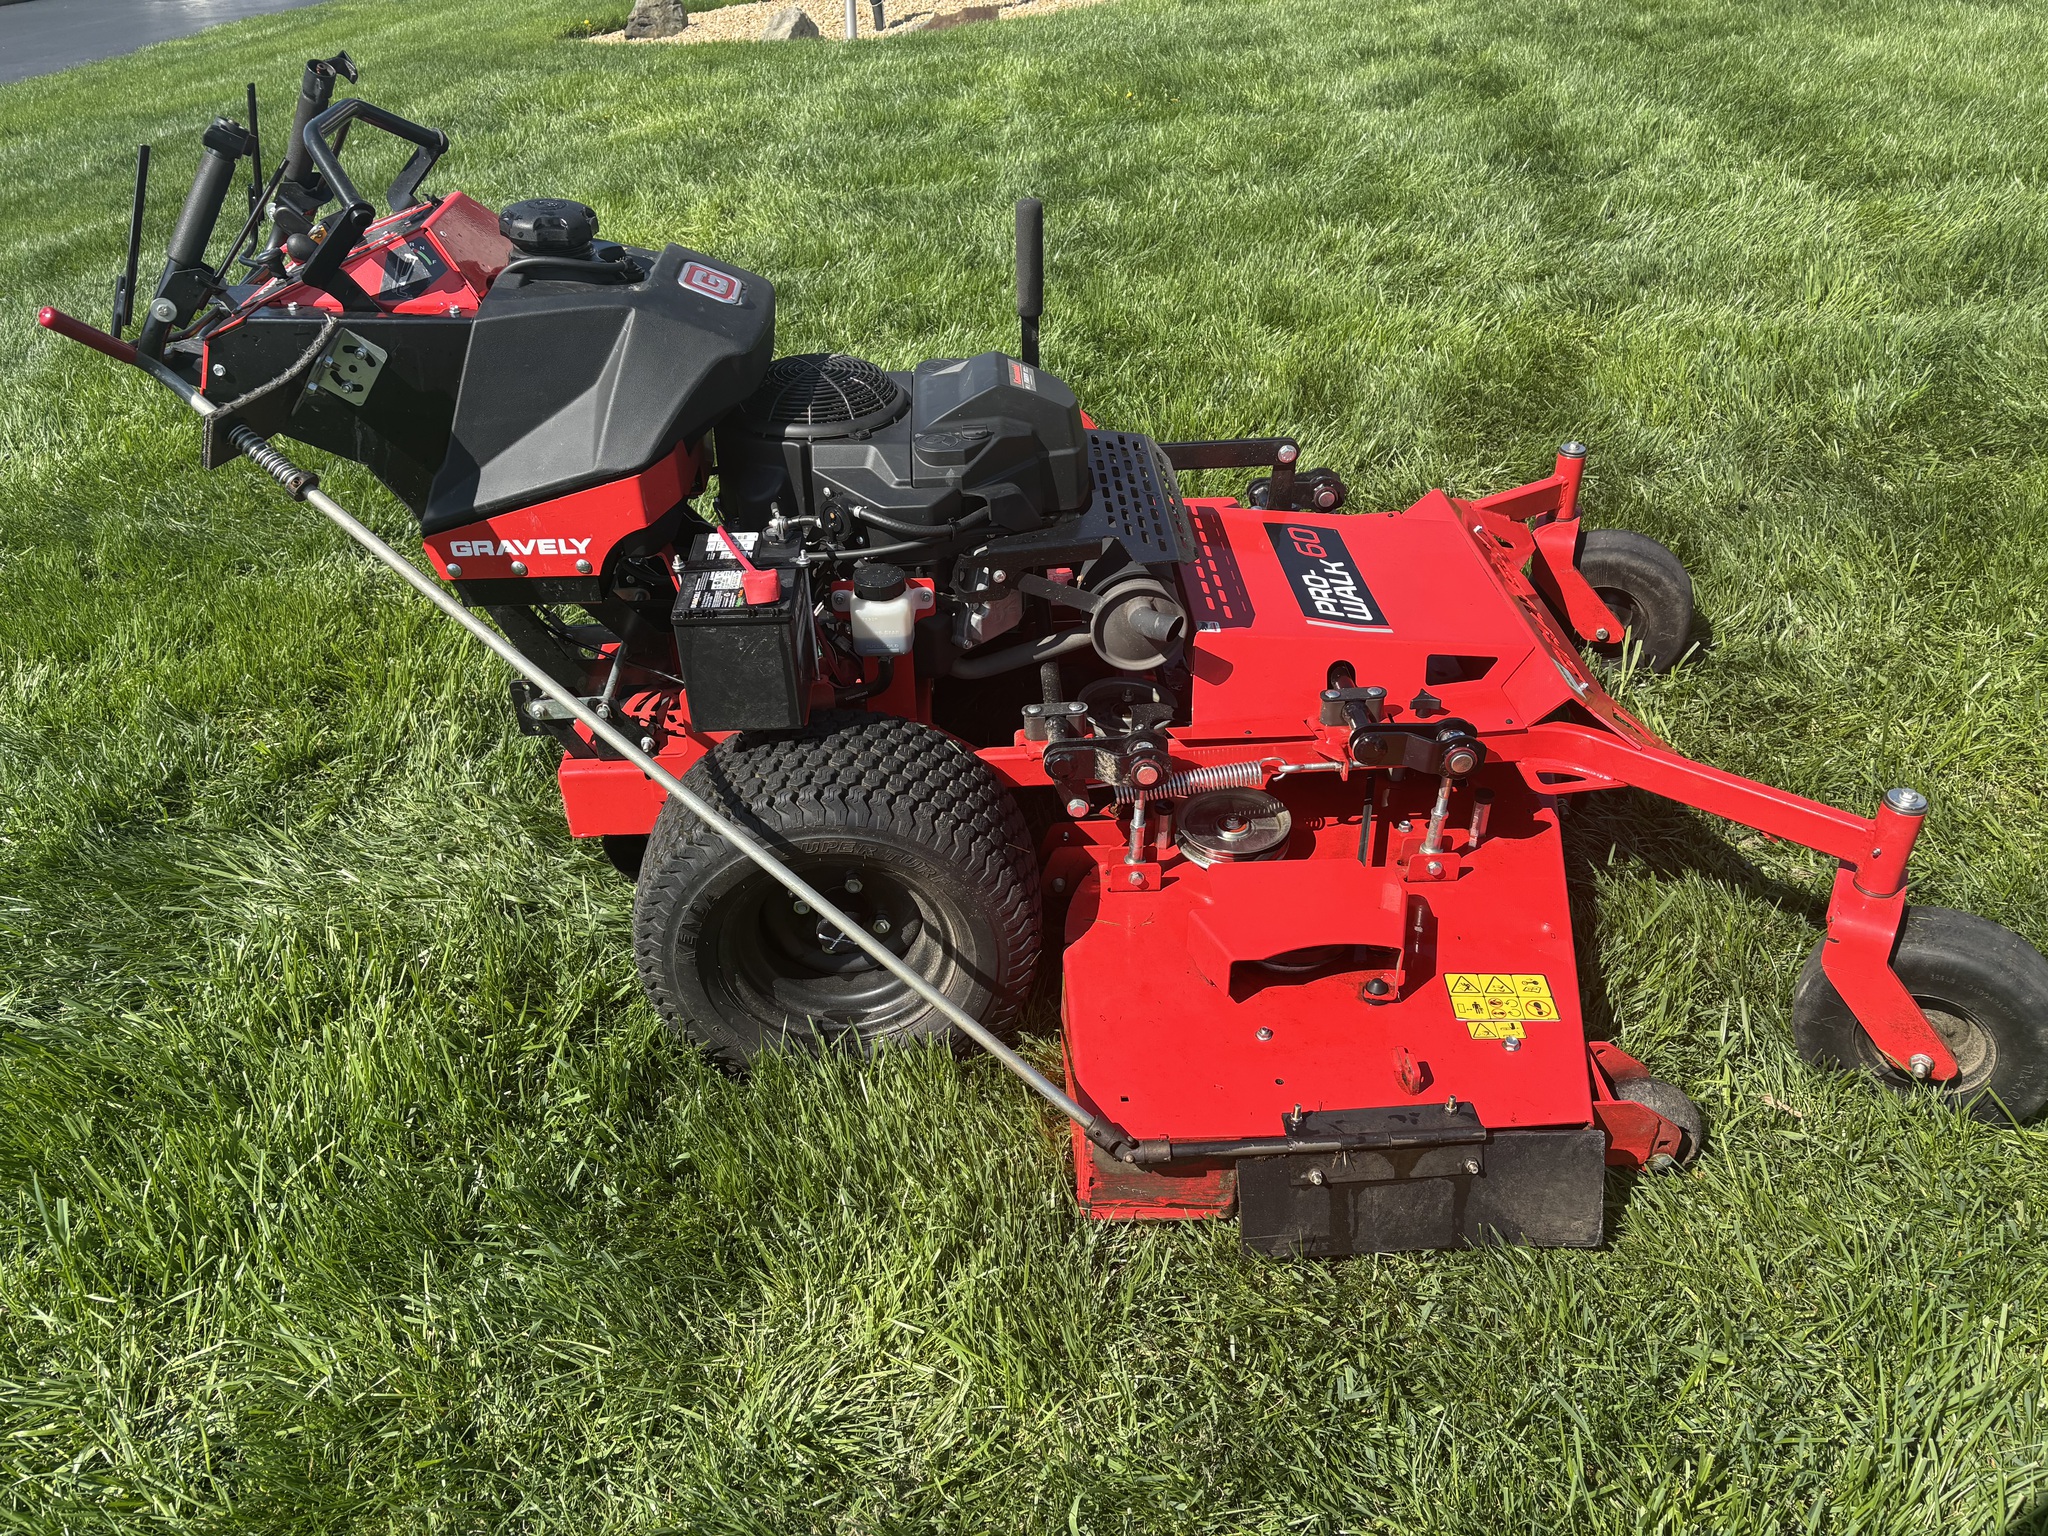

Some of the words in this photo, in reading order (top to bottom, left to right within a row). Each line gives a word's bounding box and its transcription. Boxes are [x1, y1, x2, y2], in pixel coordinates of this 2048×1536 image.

[450, 537, 592, 557] GRAVELY
[1287, 526, 1328, 559] 60
[1301, 568, 1346, 617] PRO-
[1318, 558, 1374, 621] WALK
[676, 887, 721, 966] KENDA
